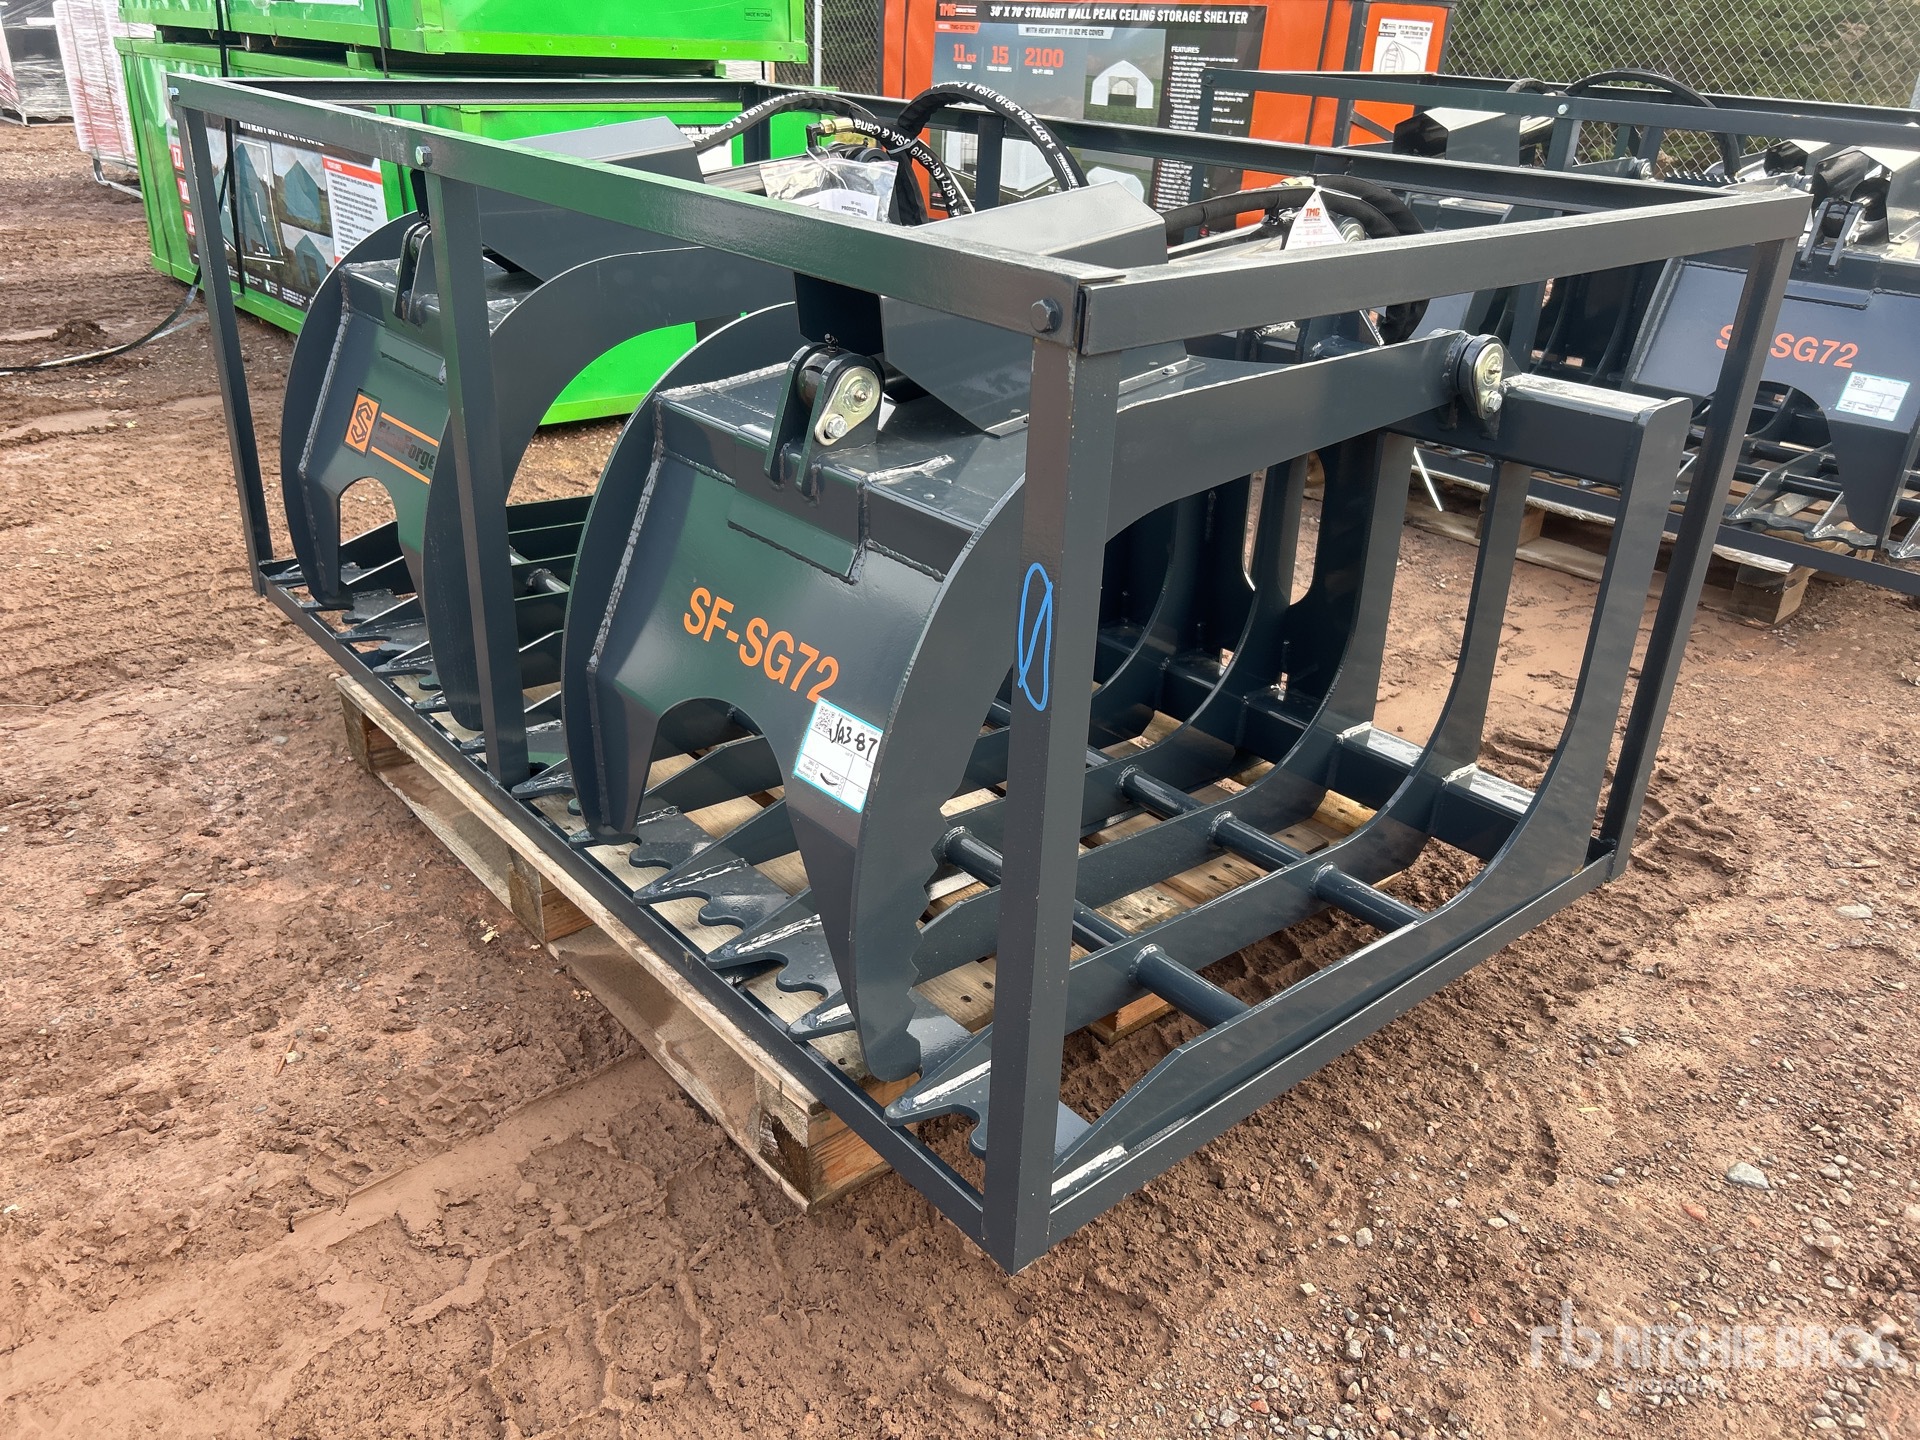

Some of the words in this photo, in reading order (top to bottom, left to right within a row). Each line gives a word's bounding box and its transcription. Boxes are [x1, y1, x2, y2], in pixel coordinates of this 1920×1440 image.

[939, 4, 956, 16] TMG
[1003, 6, 1011, 17] X
[1025, 7, 1066, 19] STRAIGHT
[1067, 8, 1092, 20] WALL
[1093, 8, 1118, 20] PEAK
[1119, 9, 1156, 22] CEILING
[1156, 10, 1201, 23] STORAGE
[1204, 11, 1248, 24] SHELTER
[953, 43, 965, 62] 11
[991, 45, 1009, 65] 15
[1024, 47, 1064, 68] 2100
[1171, 45, 1200, 53] FEATURES
[854, 118, 881, 135] Cana
[1305, 207, 1321, 217] TMG
[1715, 324, 1858, 368] SSG72
[683, 587, 840, 704] SF-SG72
